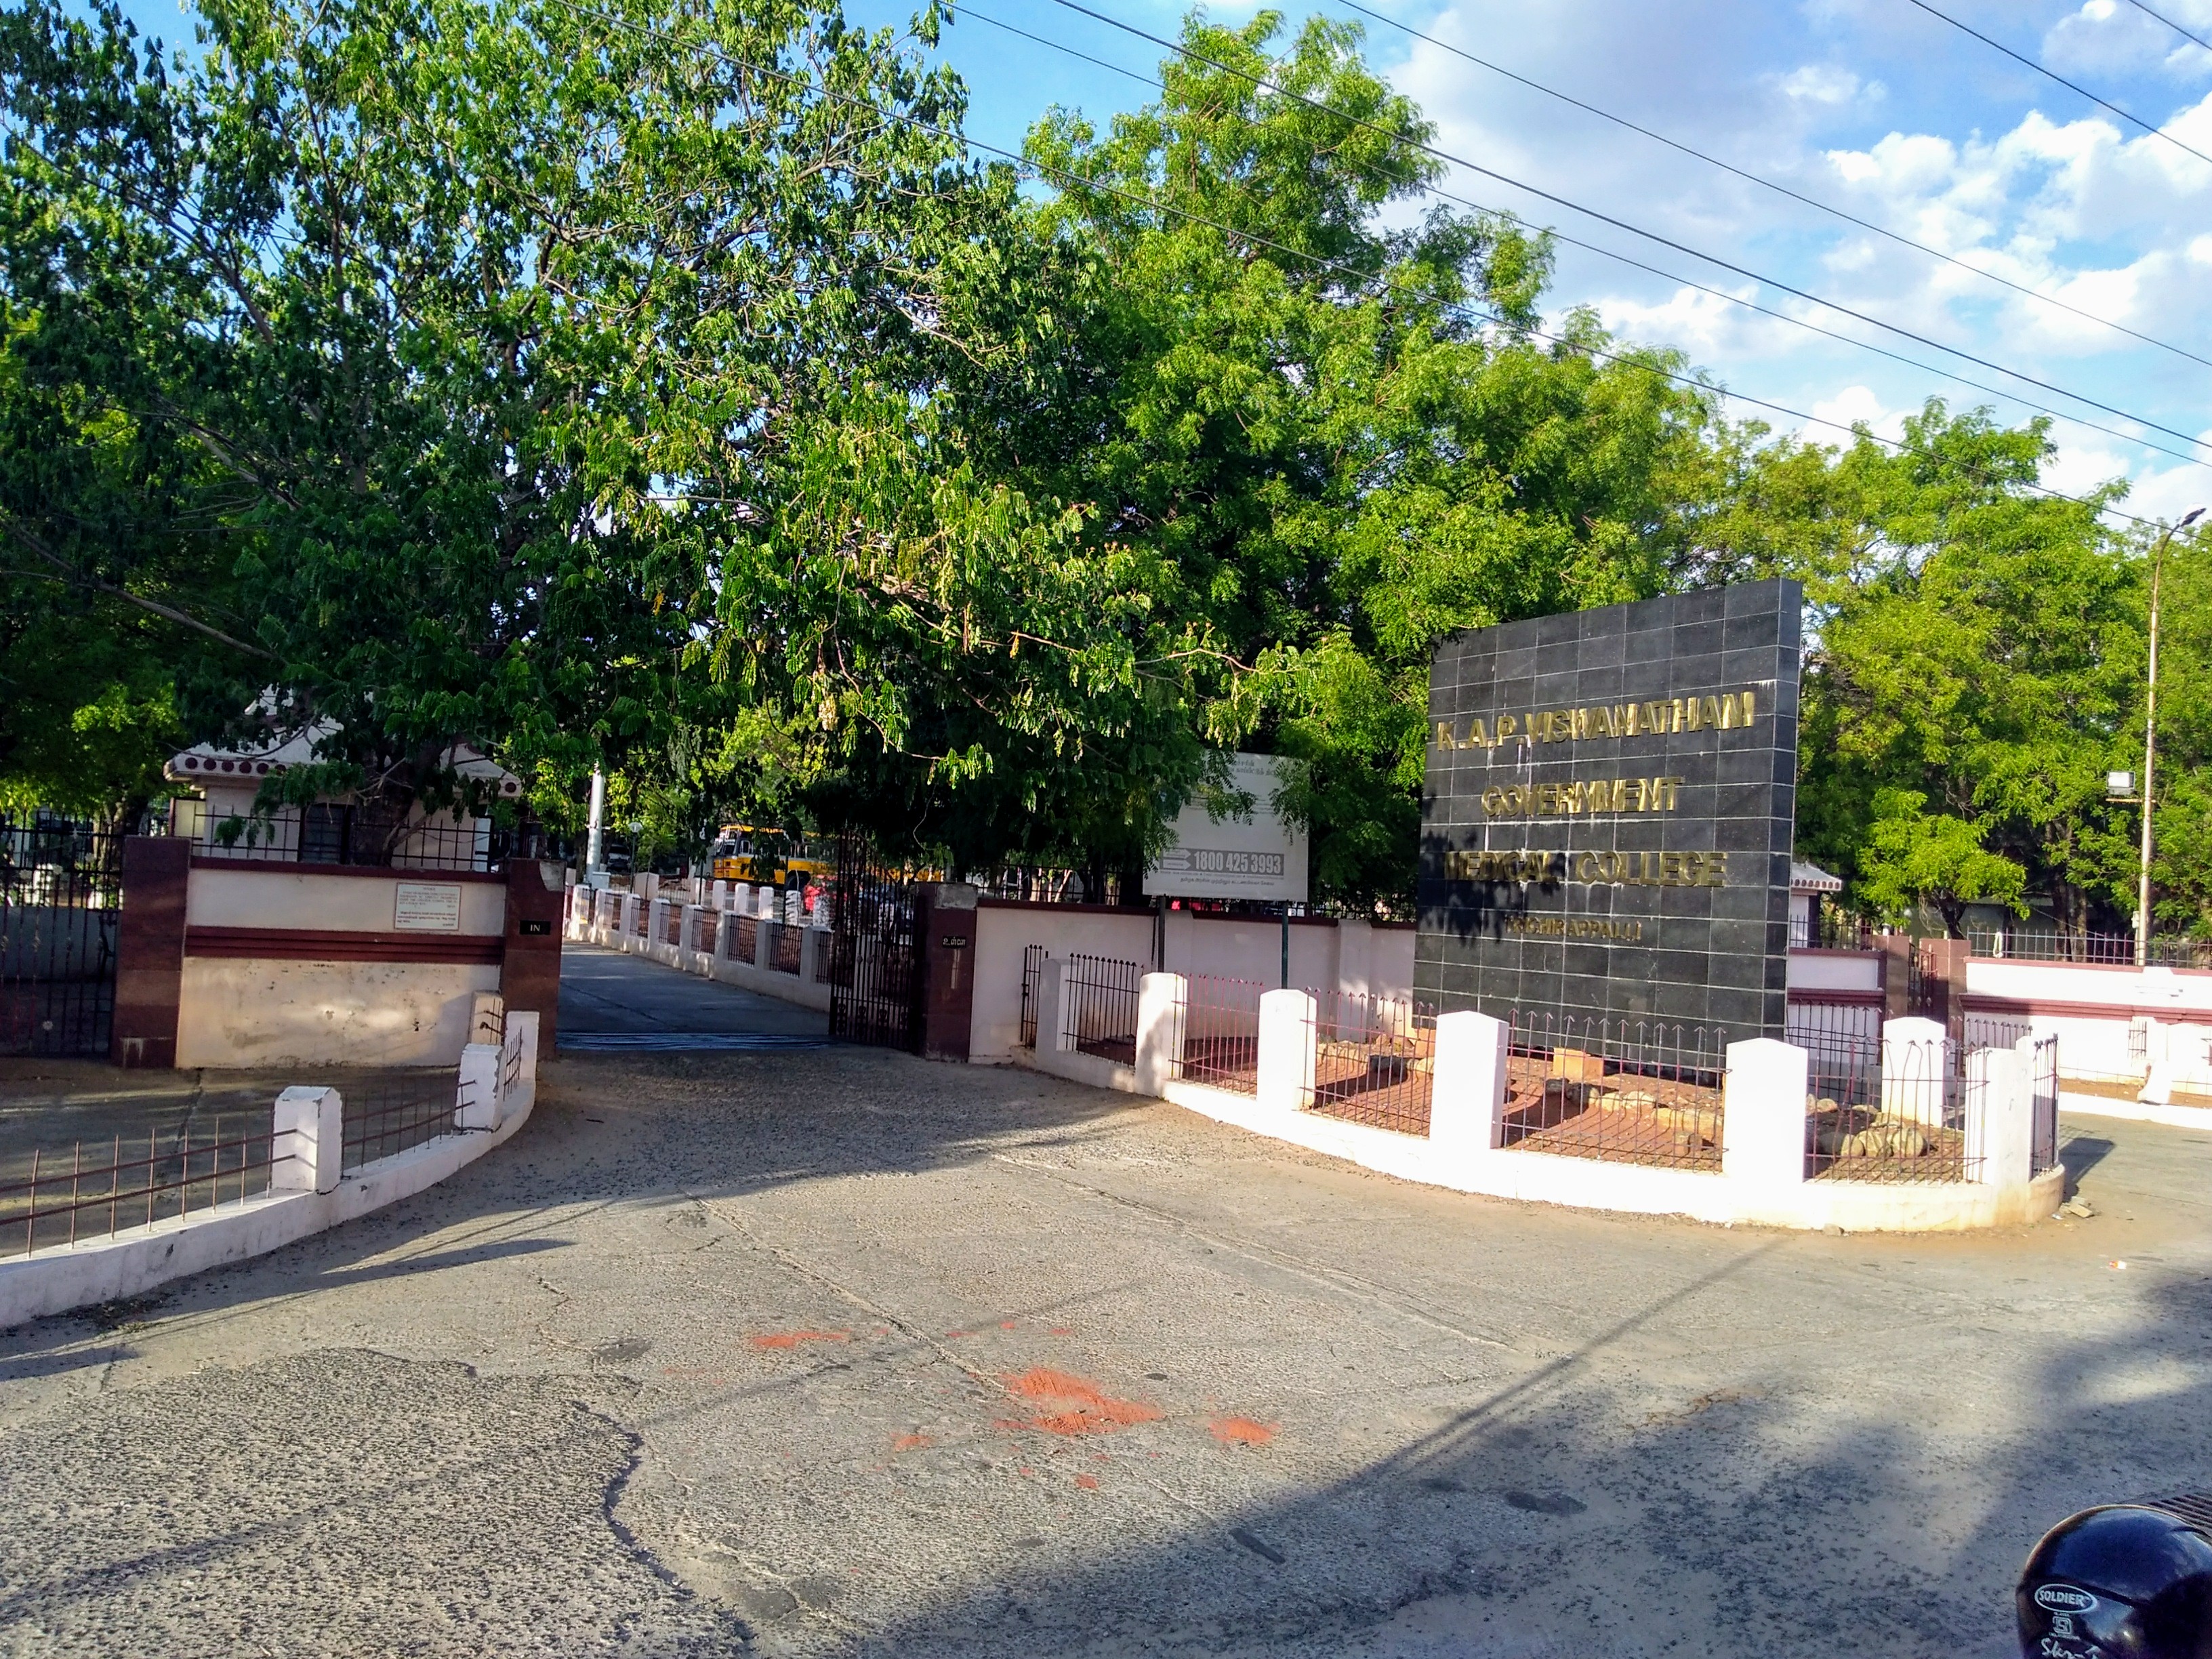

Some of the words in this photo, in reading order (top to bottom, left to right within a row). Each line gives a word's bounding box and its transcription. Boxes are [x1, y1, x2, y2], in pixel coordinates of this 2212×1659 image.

[1481, 776, 1685, 817] GOVERNMENT
[1194, 851, 1223, 871] 1800
[1226, 853, 1248, 873] 425
[1250, 854, 1281, 874] 3993
[1444, 851, 1558, 883] MEDICAL
[1574, 851, 1727, 887] COLLEGE
[529, 924, 541, 932] IN
[1504, 914, 1642, 941] TRICHIRAPPALLI
[2039, 1590, 2085, 1607] SOLDIER
